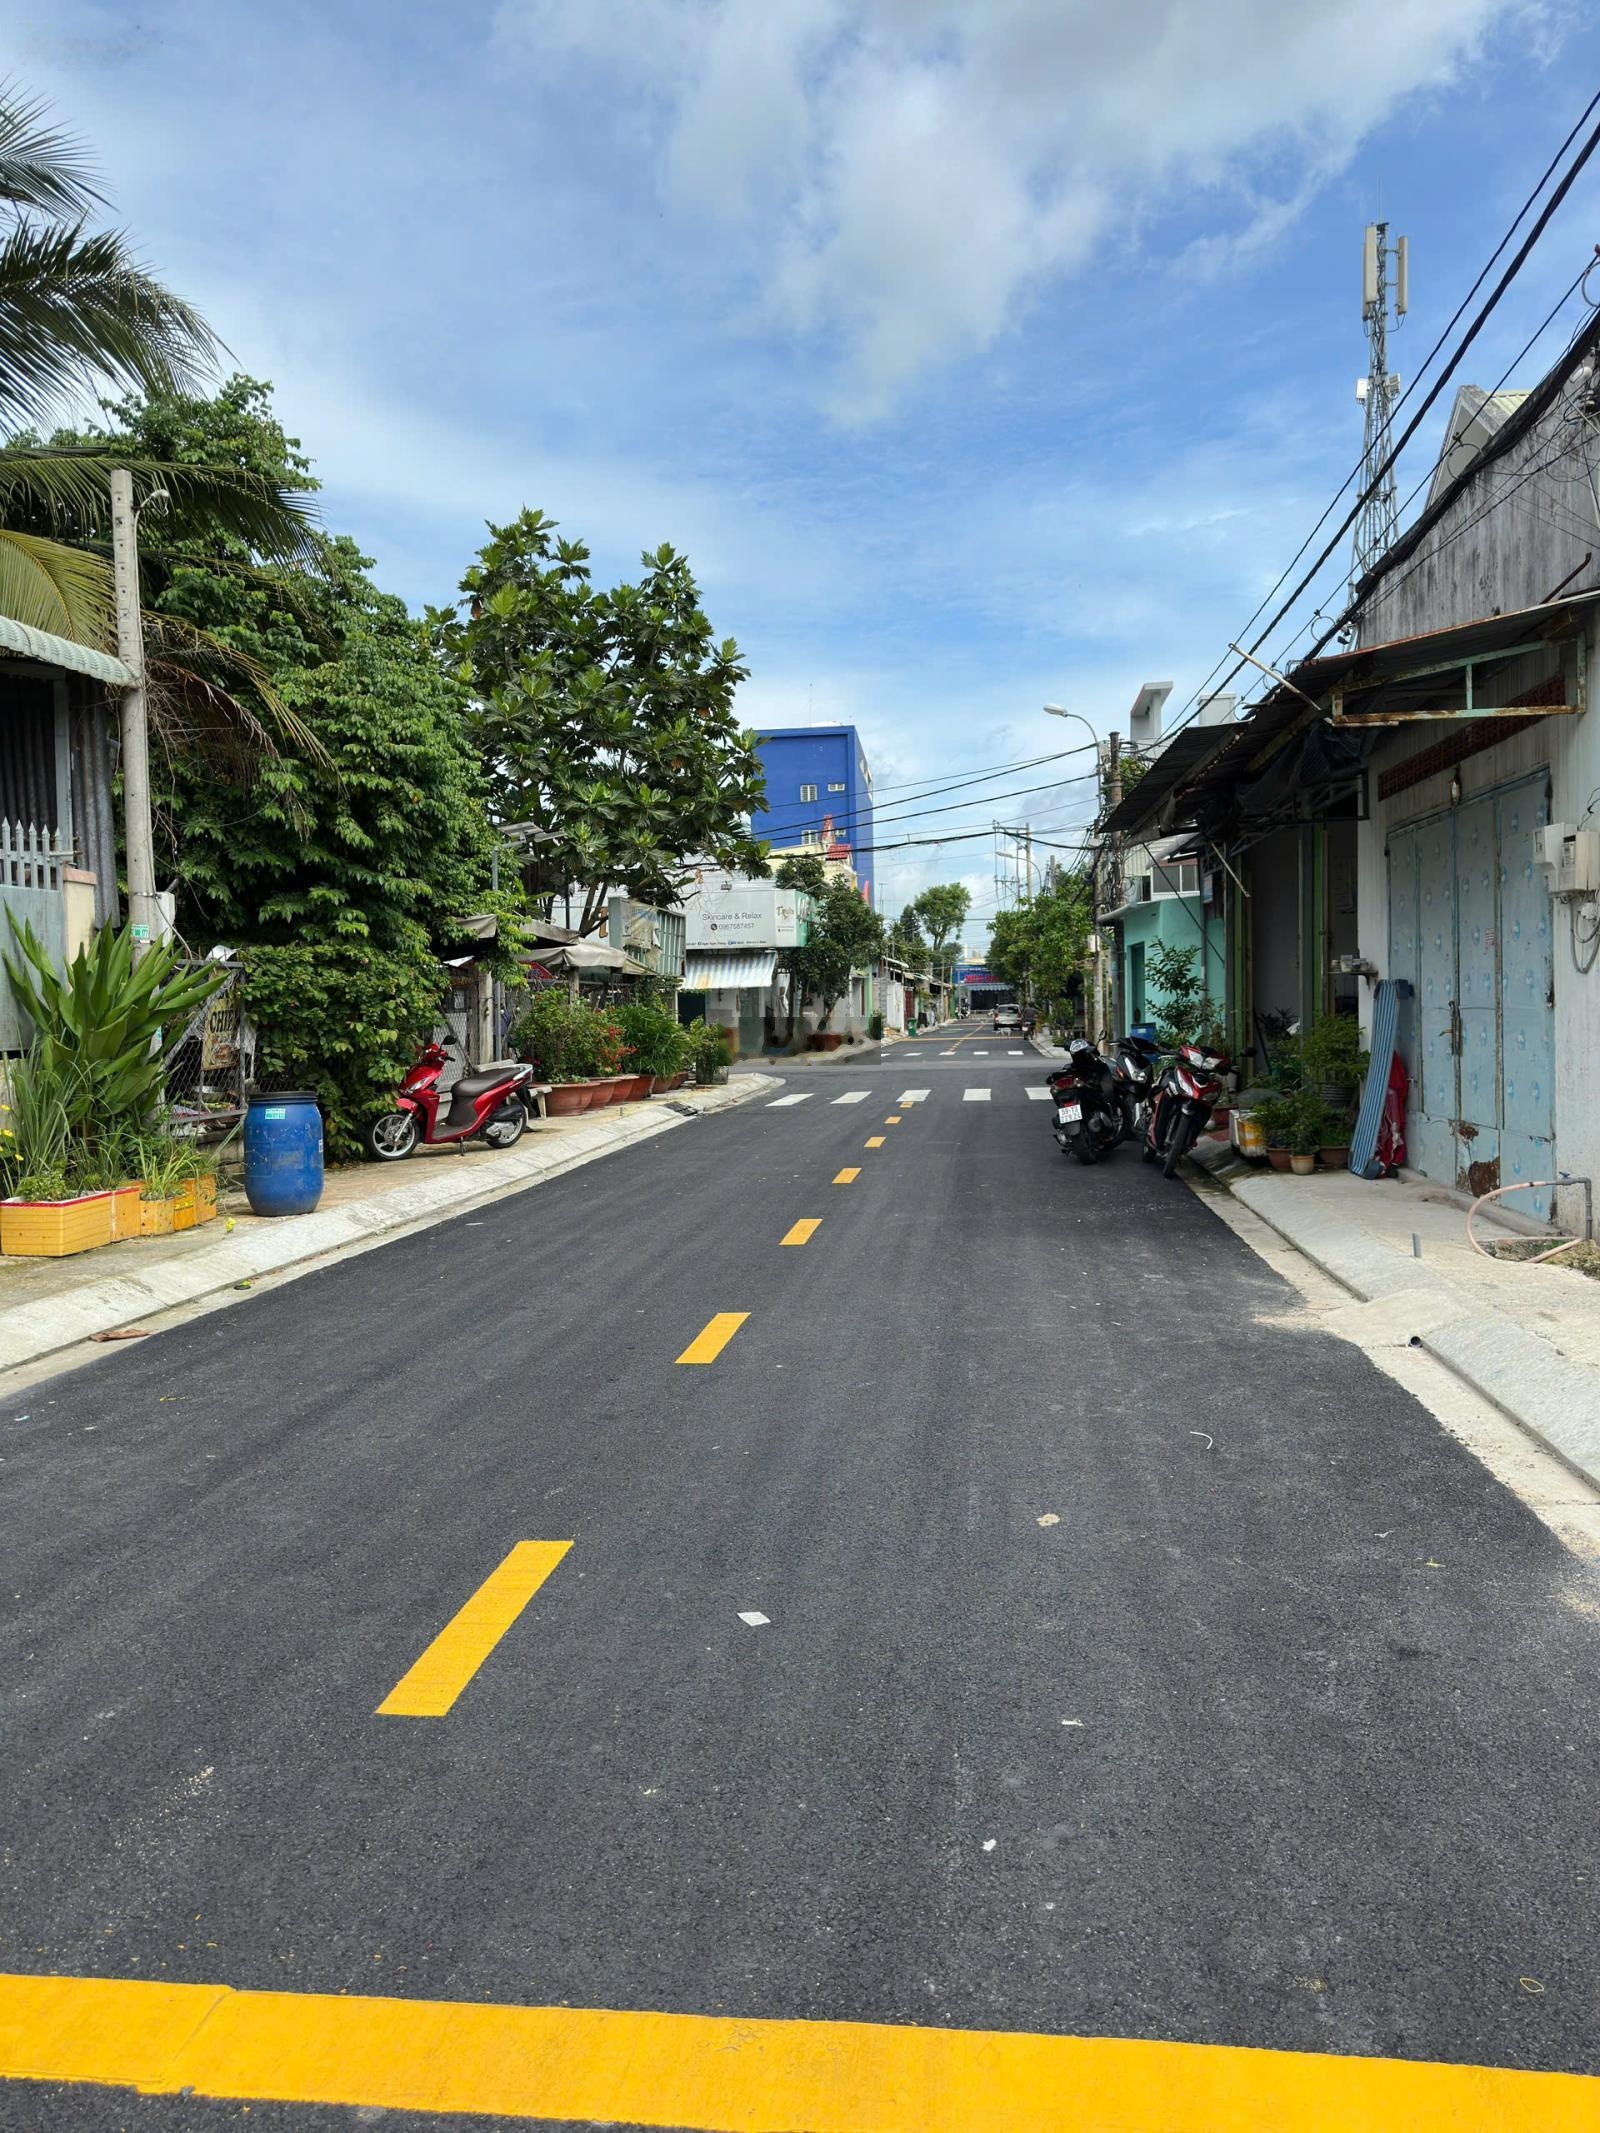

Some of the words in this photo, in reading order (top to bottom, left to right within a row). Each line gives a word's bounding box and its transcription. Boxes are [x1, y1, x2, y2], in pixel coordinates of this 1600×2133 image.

[702, 912, 732, 921] Skincare
[734, 912, 741, 920] &
[742, 911, 762, 920] Relax
